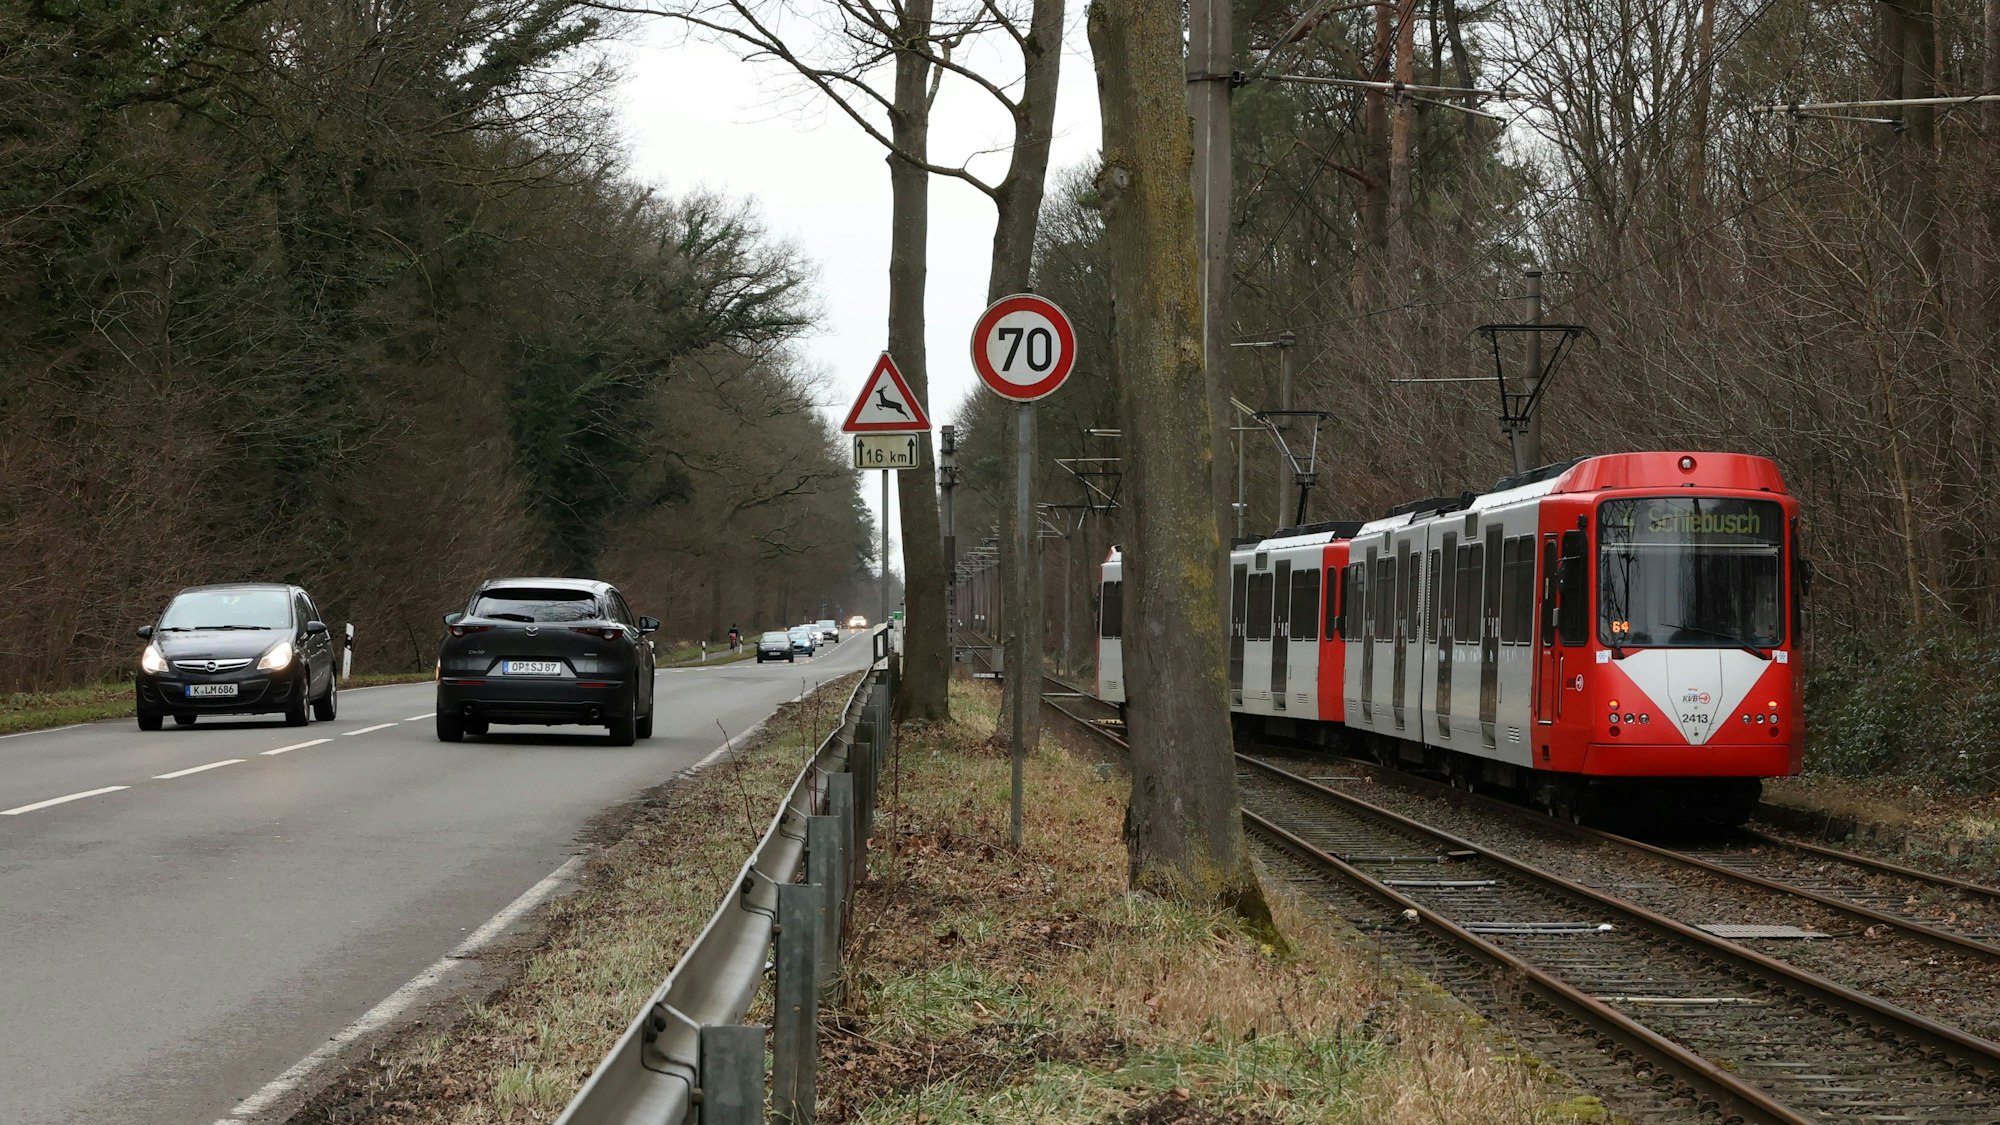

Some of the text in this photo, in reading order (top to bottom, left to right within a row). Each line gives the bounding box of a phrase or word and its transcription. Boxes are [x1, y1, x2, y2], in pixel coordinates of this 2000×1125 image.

[998, 327, 1052, 372] 70
[866, 449, 907, 464] 1.6 km
[1612, 620, 1630, 633] 64
[1682, 695, 1699, 703] KVB
[1682, 713, 1709, 724] 2413
